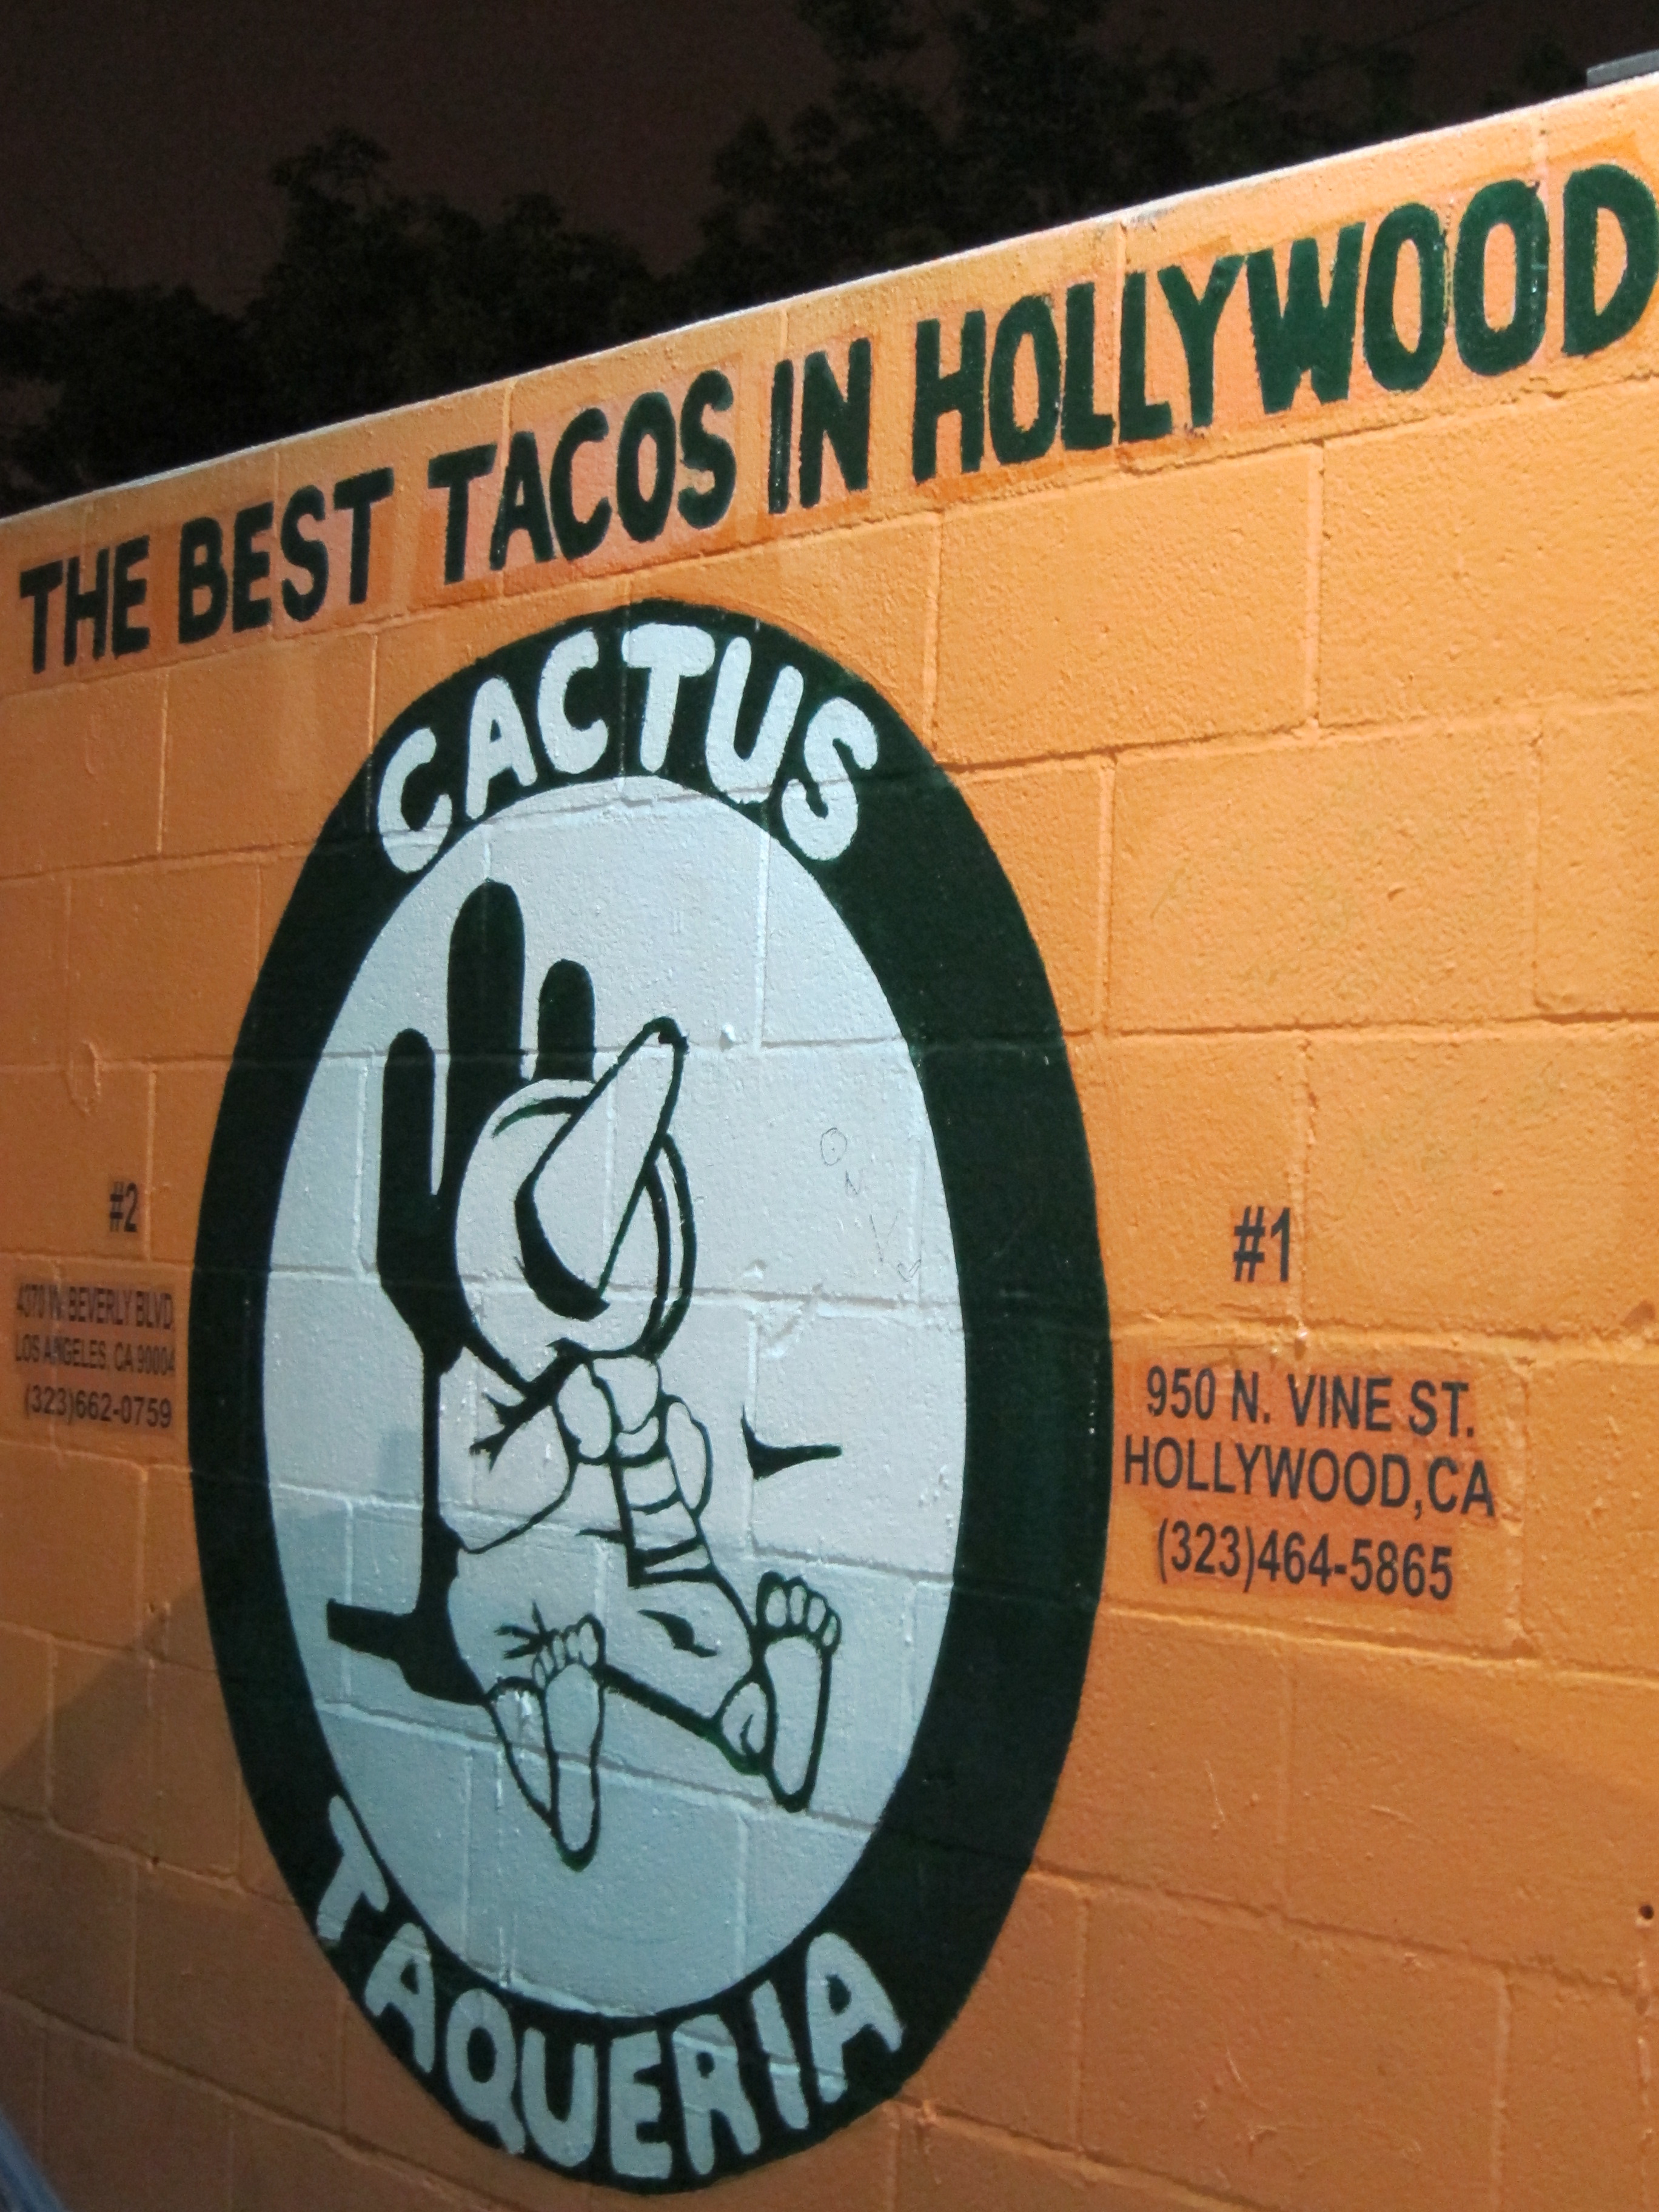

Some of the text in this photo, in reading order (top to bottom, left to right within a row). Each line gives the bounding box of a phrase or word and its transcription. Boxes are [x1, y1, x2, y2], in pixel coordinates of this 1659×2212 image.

[20, 162, 1659, 674] THE BEST TACOS IN HOLLYWOOD
[377, 622, 879, 874] CACTUS
[109, 1181, 138, 1233] #2
[1233, 1205, 1291, 1283] #1
[69, 1286, 132, 1326] BEVERLY
[15, 1333, 39, 1362] LOS
[115, 1341, 133, 1373] CA
[24, 1384, 172, 1429] (323)662-0759
[1146, 1366, 1475, 1438] 950 N. VINE ST.
[1158, 1517, 1453, 1600] (323)464-5865
[316, 1794, 907, 2181] TAQUERIA
